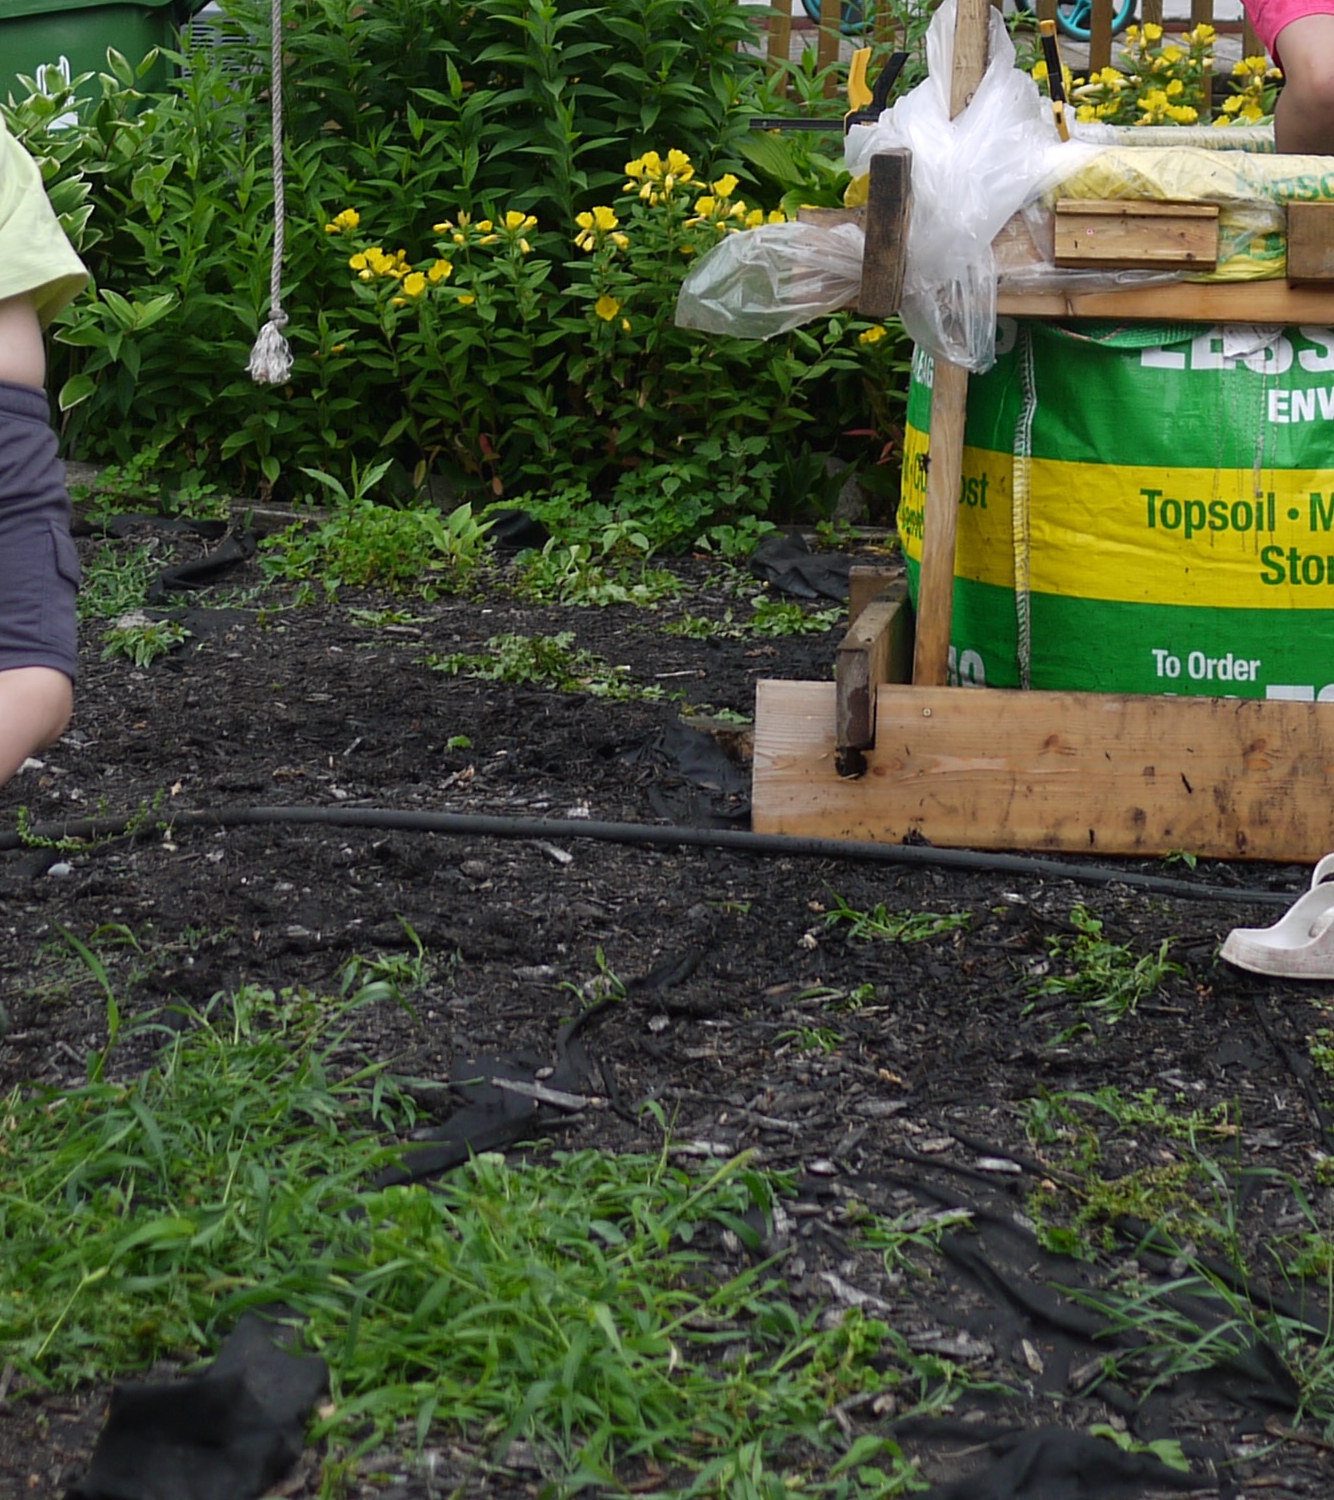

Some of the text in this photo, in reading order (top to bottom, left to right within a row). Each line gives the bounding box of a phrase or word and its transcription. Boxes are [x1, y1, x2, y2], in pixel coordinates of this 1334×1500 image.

[1140, 488, 1275, 539] Topsoil
[1152, 649, 1260, 681] To Order
